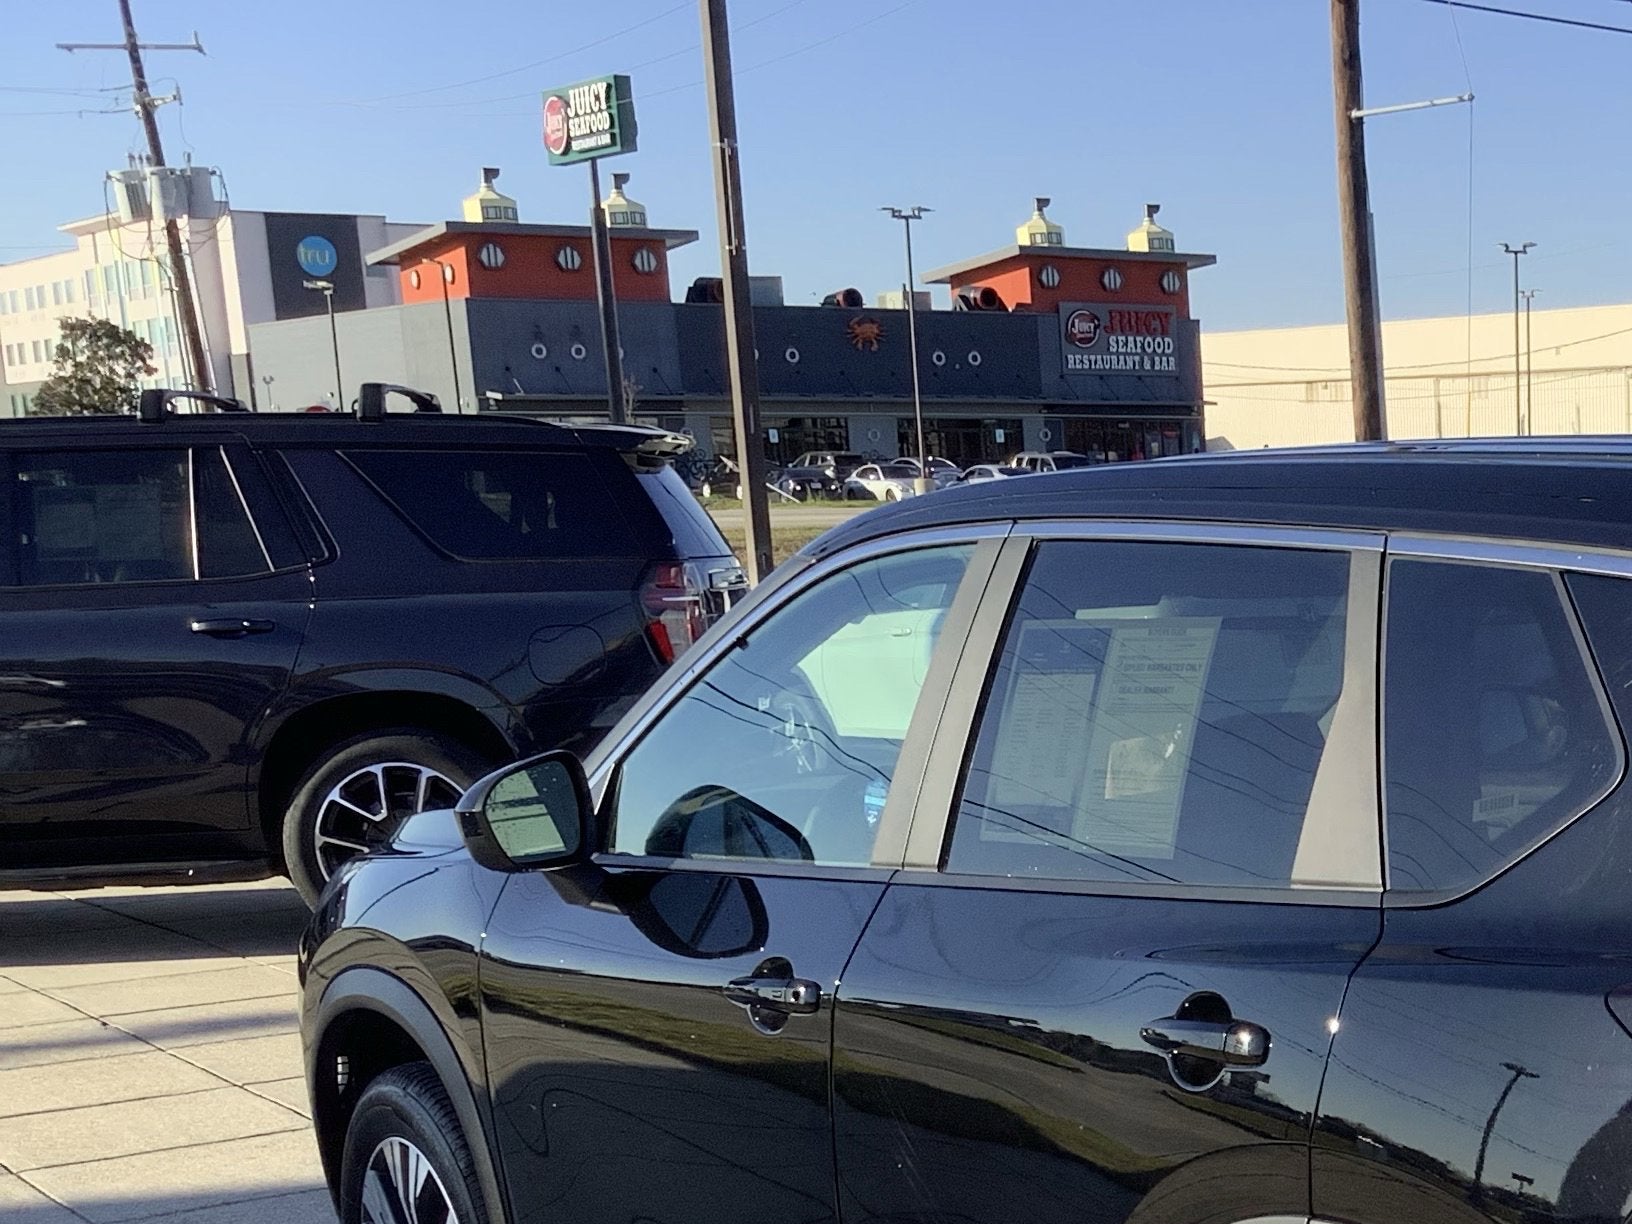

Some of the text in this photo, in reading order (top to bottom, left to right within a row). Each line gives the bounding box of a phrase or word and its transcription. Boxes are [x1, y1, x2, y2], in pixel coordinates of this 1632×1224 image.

[567, 81, 608, 118] JUICY
[568, 111, 610, 138] SEAFOOD
[1104, 310, 1170, 336] JUICY
[1109, 336, 1174, 354] SEAFOOD
[1067, 354, 1177, 371] RESTAURANT & BAR
